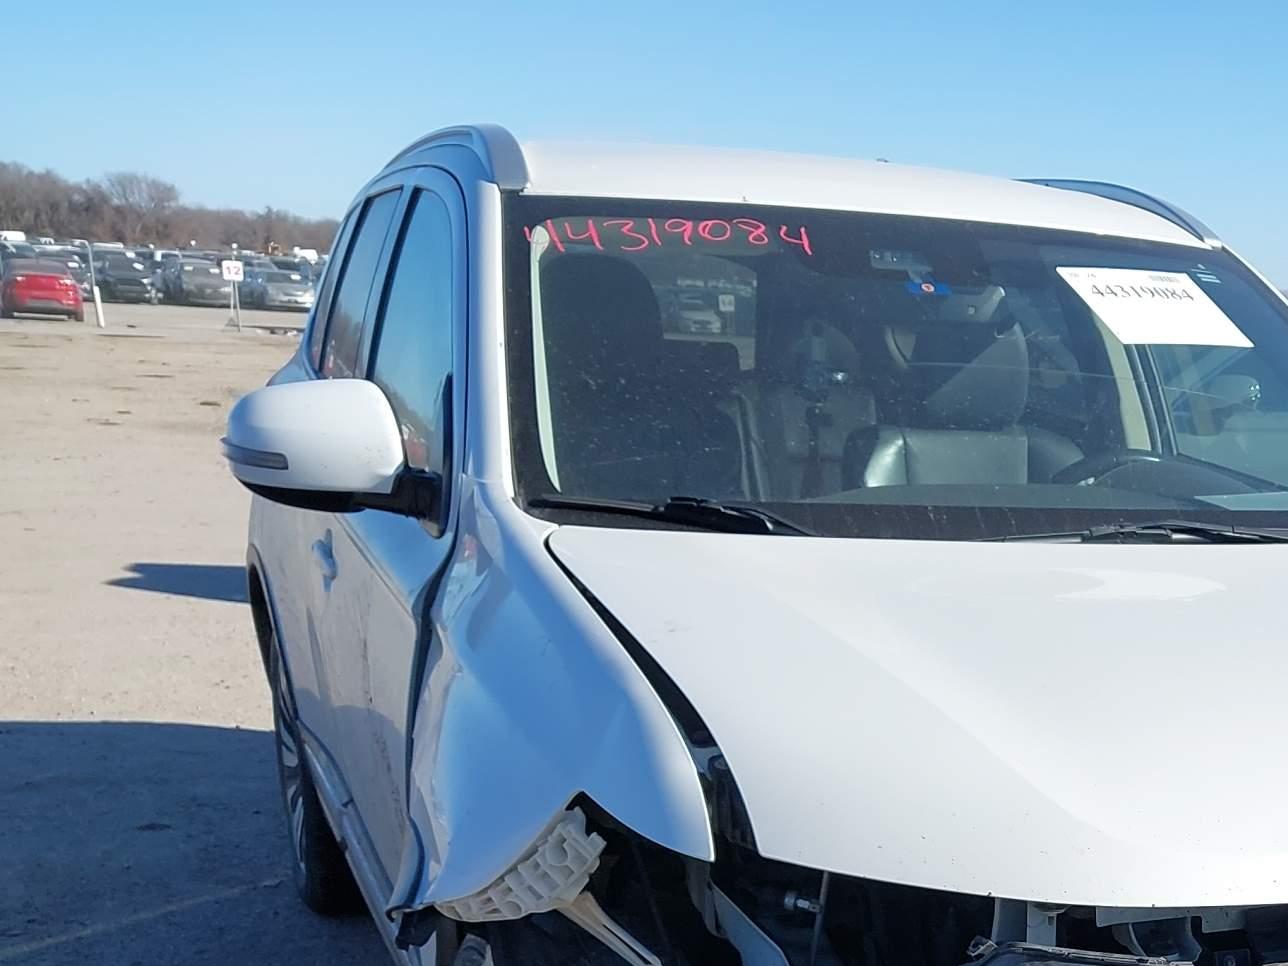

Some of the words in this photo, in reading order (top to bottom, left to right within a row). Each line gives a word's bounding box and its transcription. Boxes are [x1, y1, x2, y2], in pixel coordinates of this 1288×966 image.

[524, 217, 813, 256] 44319084
[225, 265, 241, 276] 12
[1091, 284, 1195, 301] 44319084
